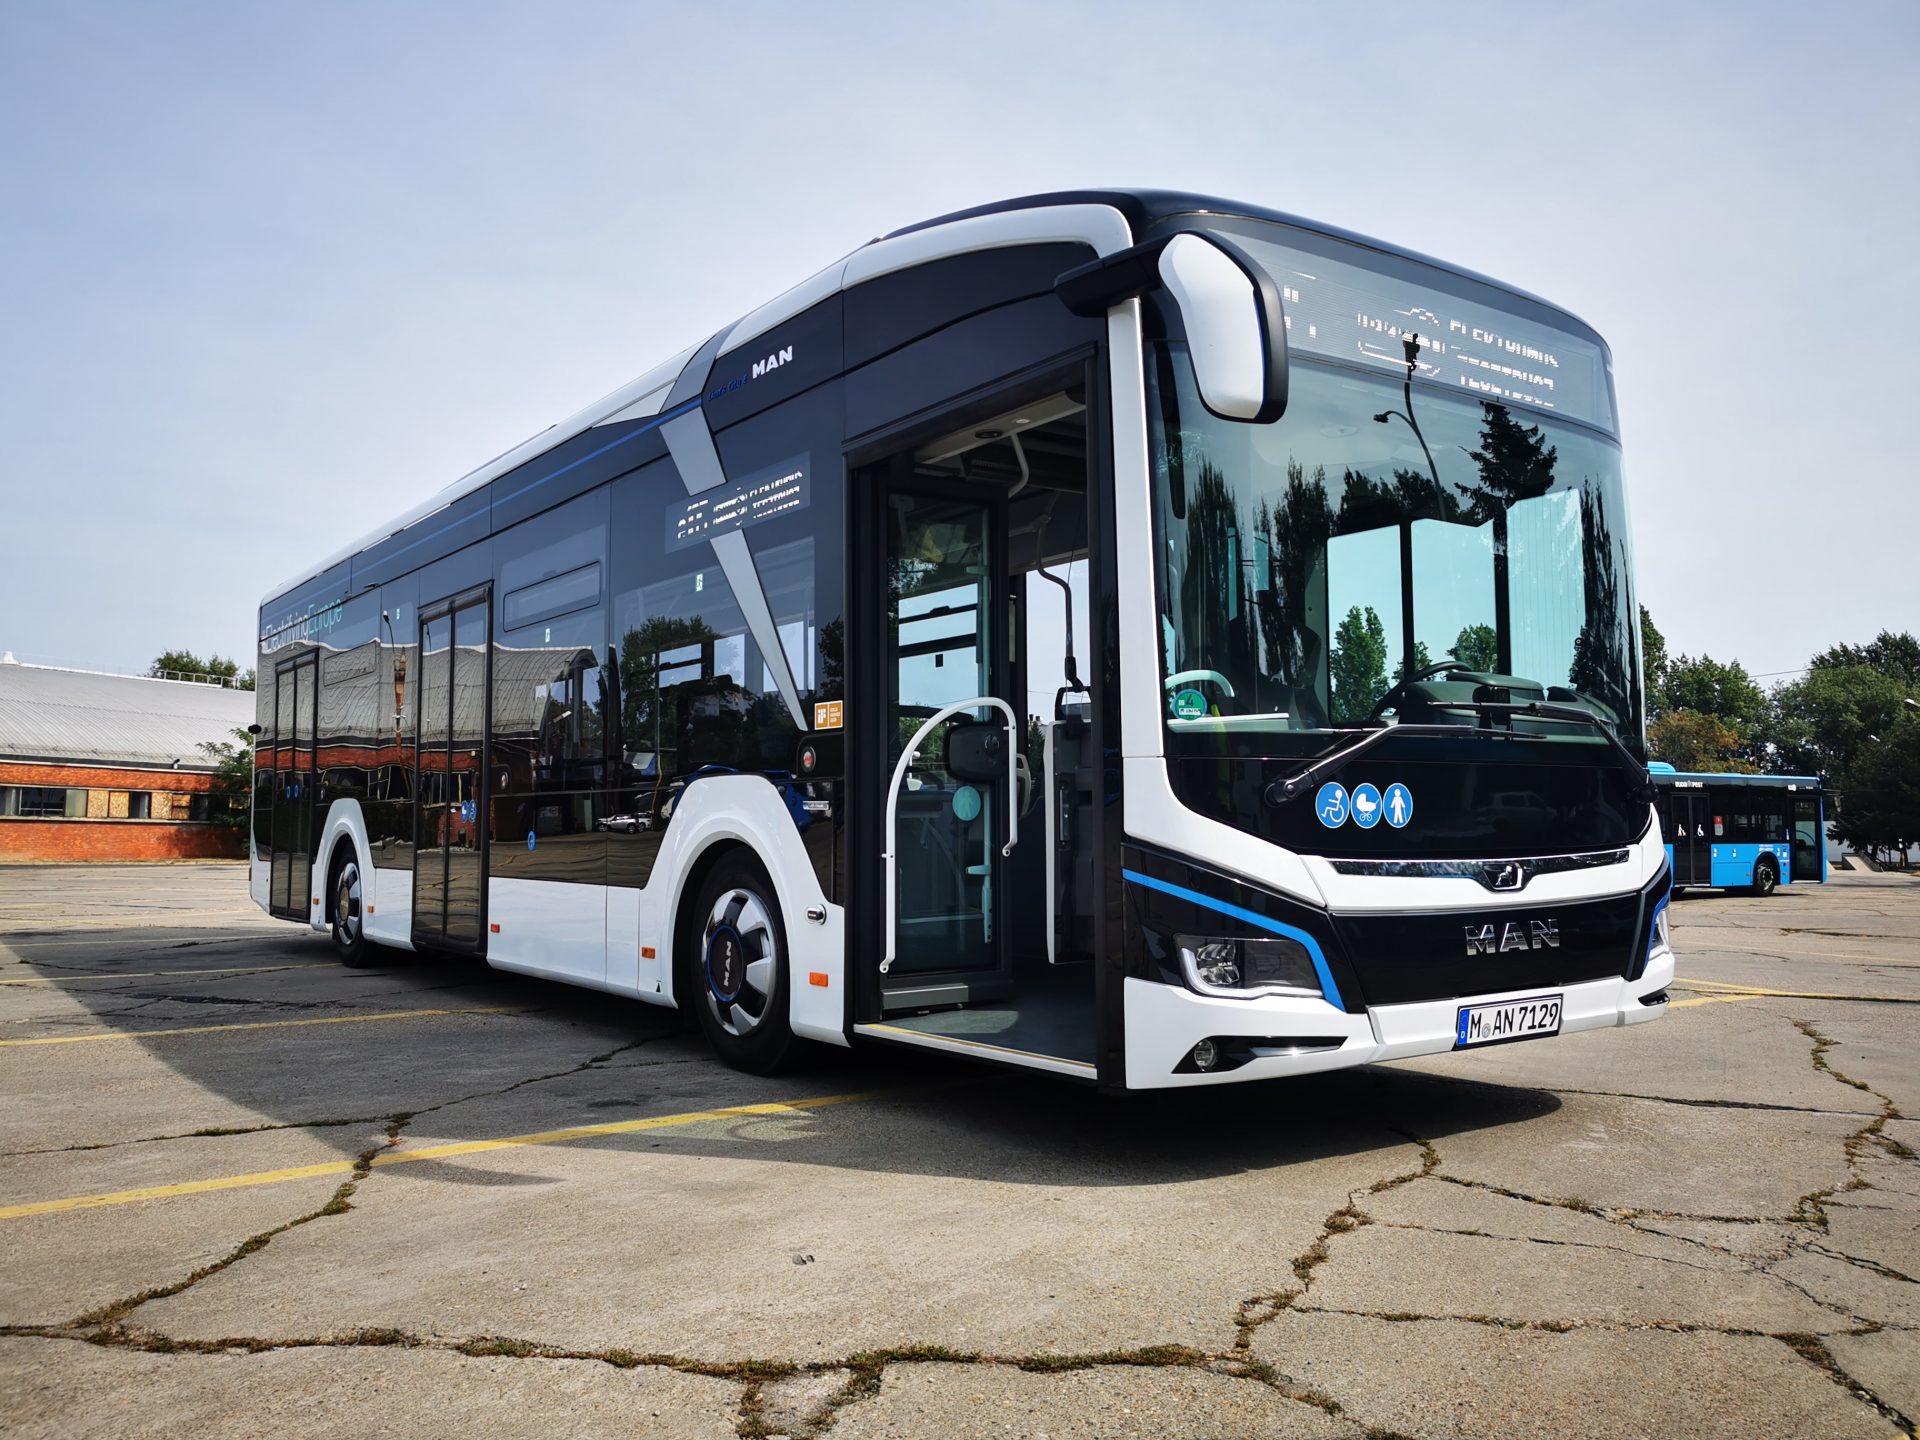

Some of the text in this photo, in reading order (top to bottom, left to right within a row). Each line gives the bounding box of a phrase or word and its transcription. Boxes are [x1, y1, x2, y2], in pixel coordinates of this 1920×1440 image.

[752, 345, 793, 379] MAN
[1185, 693, 1194, 707] 4
[1464, 918, 1560, 956] MAN
[723, 940, 732, 987] MAN
[1469, 1002, 1559, 1039] M AN 7129
